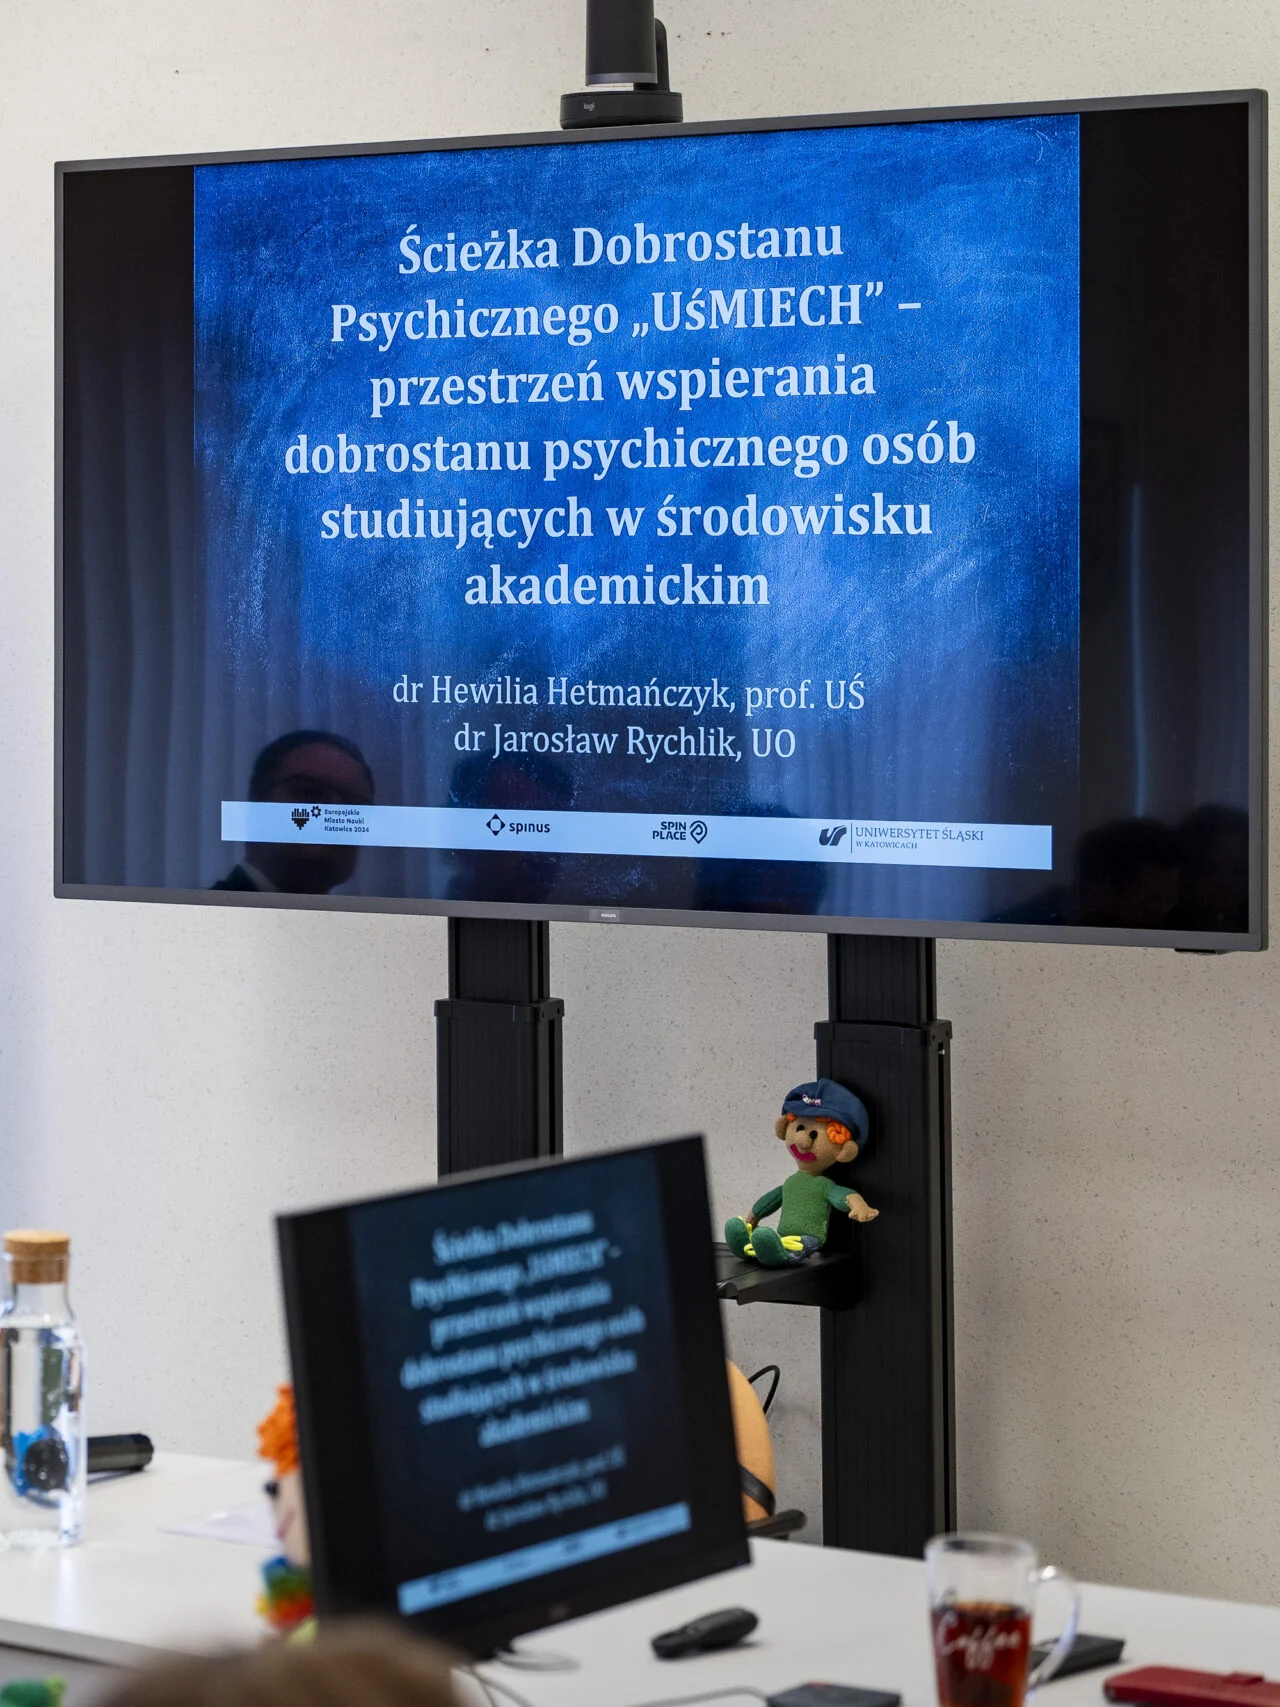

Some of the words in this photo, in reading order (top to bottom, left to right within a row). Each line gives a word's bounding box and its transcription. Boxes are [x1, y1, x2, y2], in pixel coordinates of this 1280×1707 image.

[583, 102, 595, 112] logi
[398, 223, 560, 275] Ścieżka
[572, 222, 844, 267] Dobrostanu
[330, 298, 619, 352] Psychicznego
[631, 281, 884, 338] „UśMIECH”
[369, 359, 605, 419] przestrzeń
[615, 353, 877, 411] wspierania
[284, 433, 531, 475] dobrostanu
[543, 426, 848, 481] psychicznego
[862, 420, 976, 466] osób
[320, 496, 594, 550] studiujących
[606, 507, 646, 537] w
[656, 492, 934, 537] środowisku
[464, 563, 772, 606] akademickim
[392, 674, 424, 703] dr
[431, 675, 539, 705] Hewilia
[547, 676, 736, 716] Hetmańczyk,
[744, 679, 815, 717] prof.
[824, 673, 866, 710] UŚ
[453, 722, 486, 751] dr
[492, 723, 619, 758] Jarosław
[626, 725, 743, 763] Rychlik,
[751, 728, 796, 758] UO
[508, 821, 551, 835] spinus
[652, 829, 687, 841] PLACE
[660, 820, 687, 831] SPIN
[855, 826, 940, 840] UNIWERSYTET
[941, 826, 984, 843] ŚLĄSKI
[855, 840, 863, 848] W
[864, 840, 918, 849] KATOWICACH
